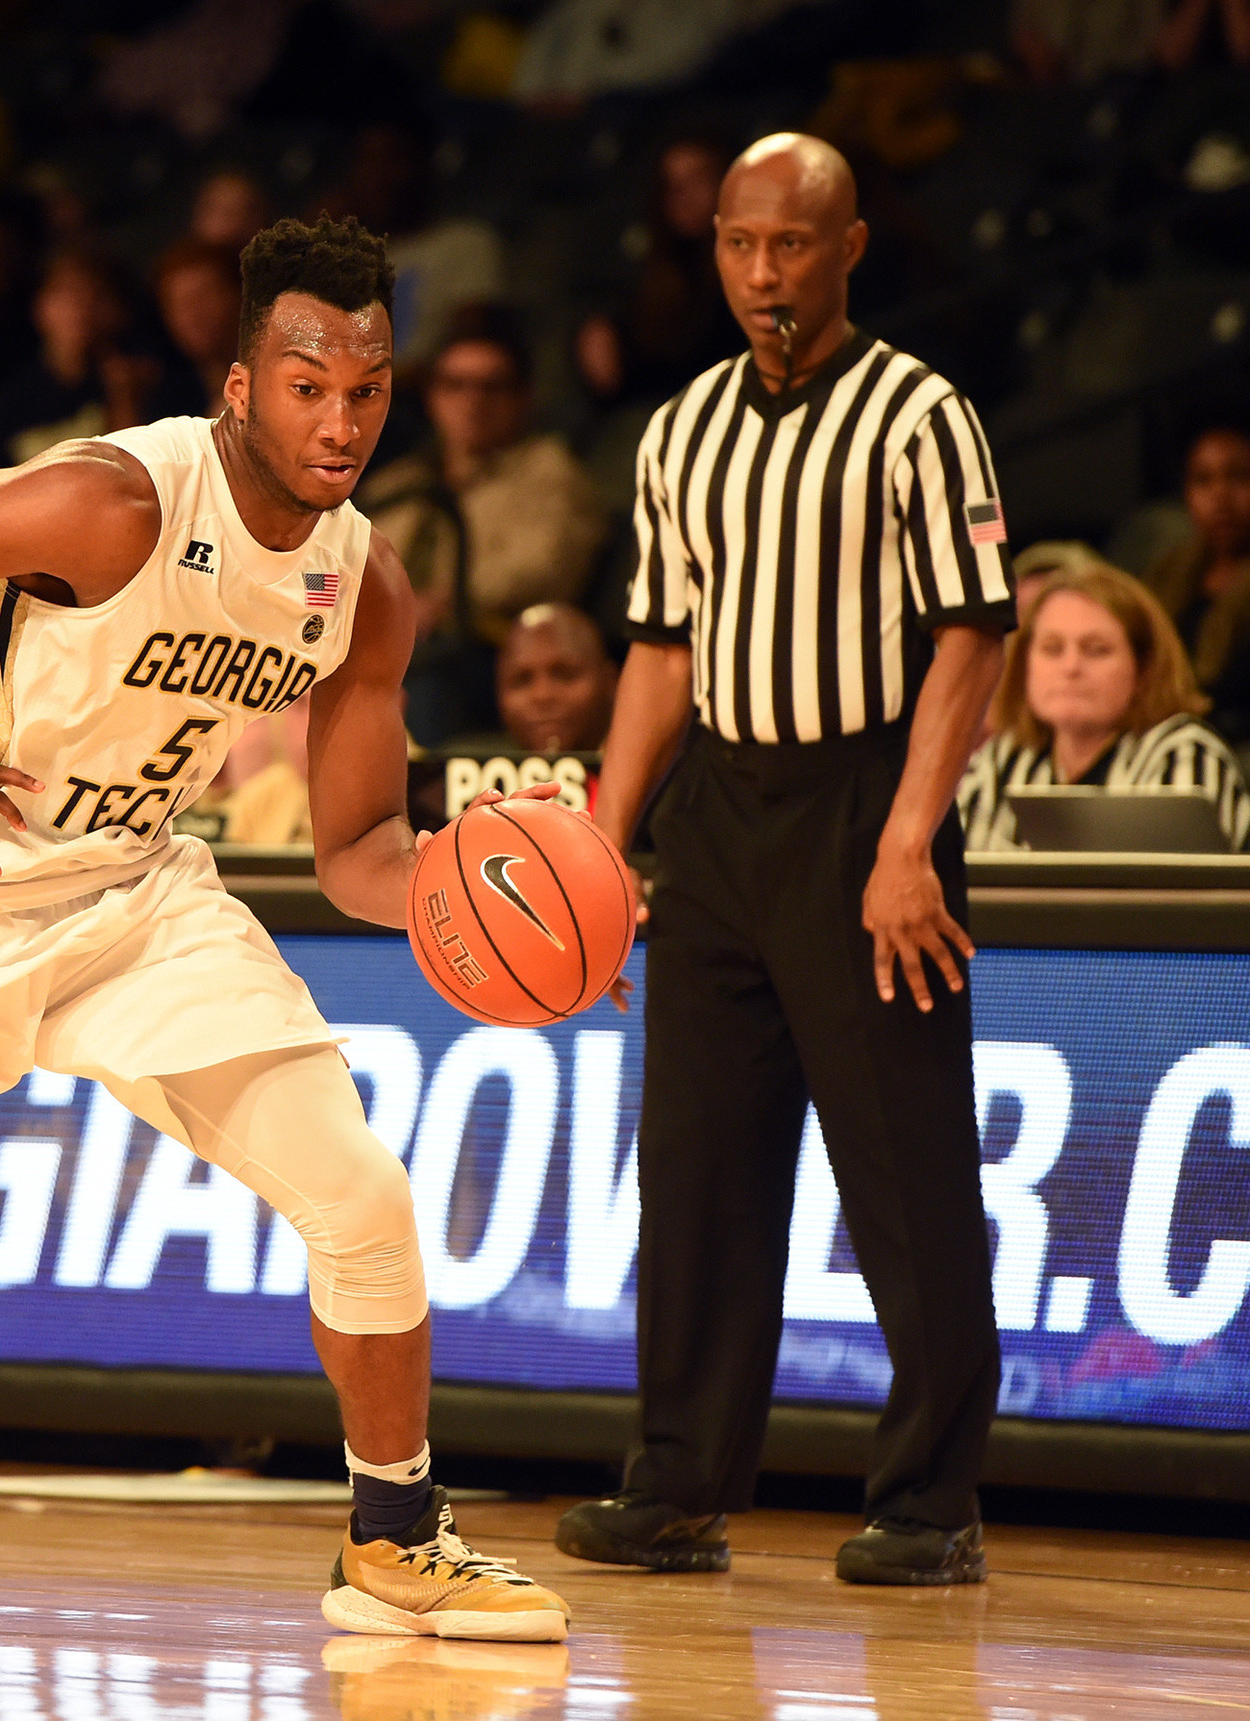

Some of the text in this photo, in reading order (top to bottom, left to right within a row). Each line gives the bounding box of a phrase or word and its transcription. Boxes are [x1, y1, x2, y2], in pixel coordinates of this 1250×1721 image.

[177, 559, 214, 574] RUSSELL
[122, 630, 319, 713] GEORGIA
[138, 715, 225, 783] 5
[422, 897, 471, 990] CHAMPIONSHIP
[428, 888, 490, 988] ELITE
